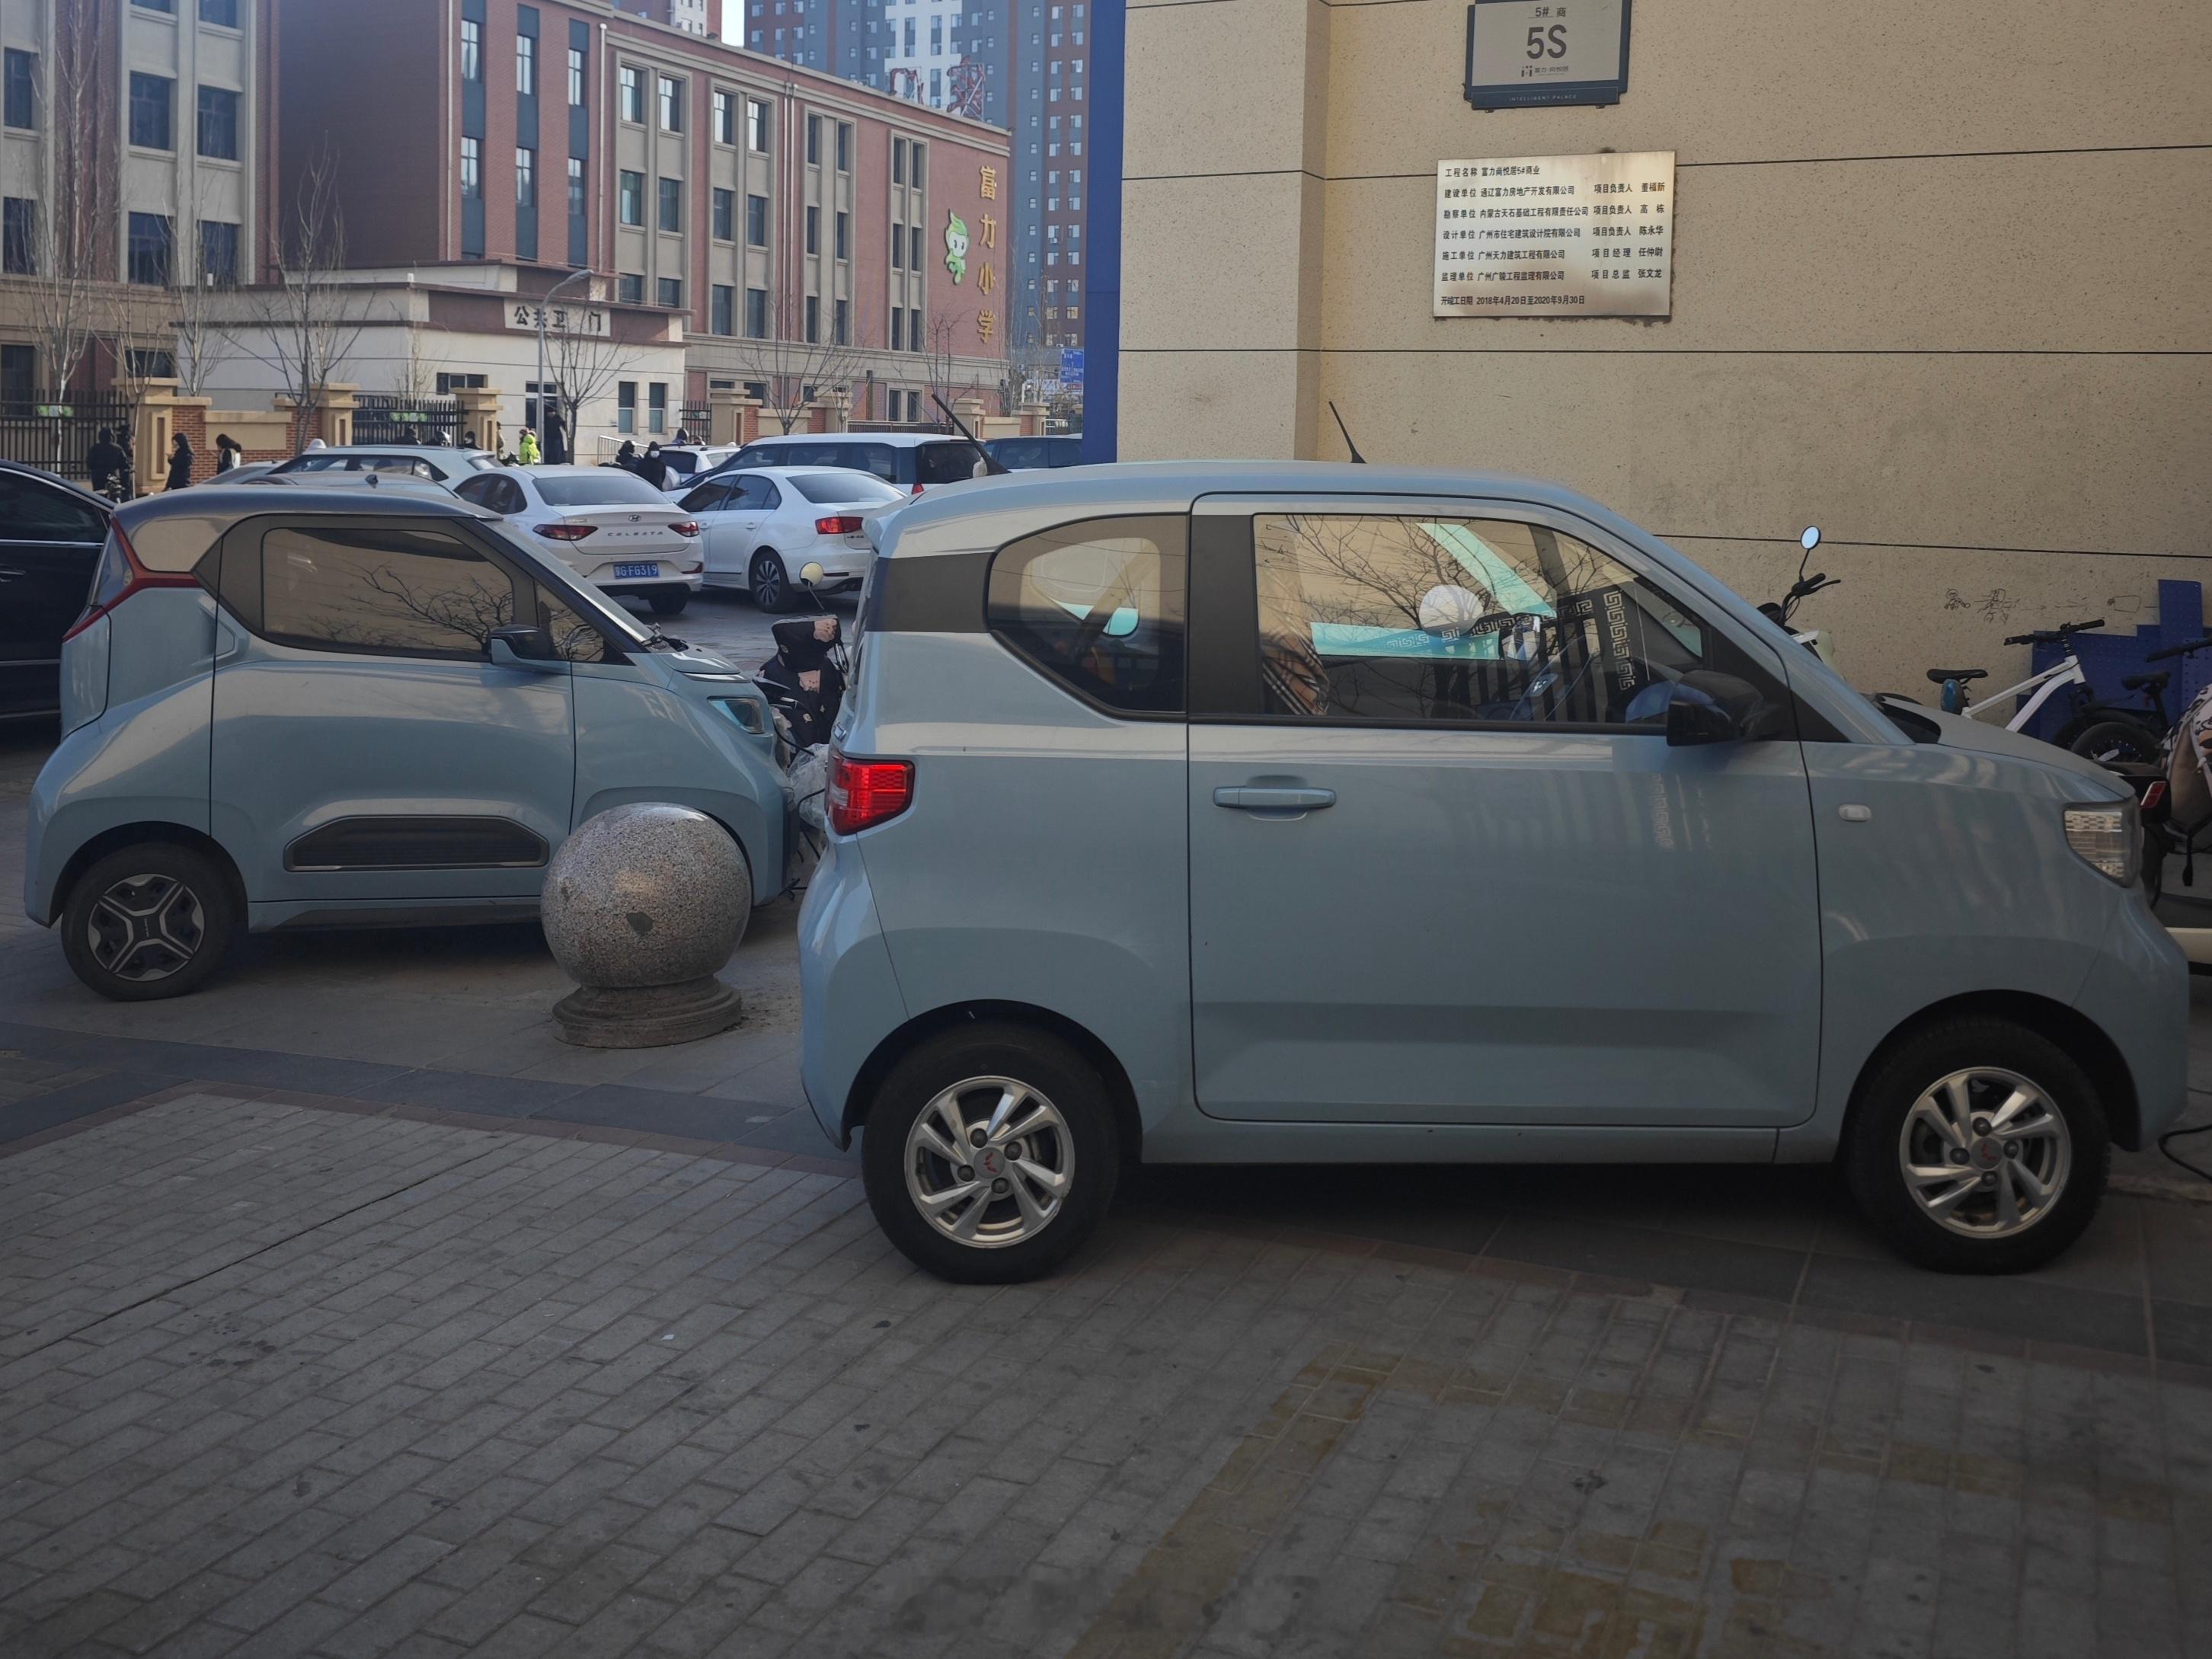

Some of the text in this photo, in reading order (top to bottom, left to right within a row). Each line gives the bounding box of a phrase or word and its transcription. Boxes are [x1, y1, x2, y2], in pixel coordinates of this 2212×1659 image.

[1556, 7, 1567, 18] 商
[1526, 24, 1568, 59] 5S
[1445, 167, 1478, 177] 工程名称
[1444, 188, 1477, 198] 建设单位
[1480, 185, 1574, 198] 通辽富力房地产开发有限公司
[1593, 183, 1633, 193] 项目负责人
[1443, 209, 1476, 219] 勘察单位
[1479, 206, 1589, 219] 内蒙古天石基础工程有限责任公司
[1593, 205, 1632, 216] 项目负责人
[1443, 225, 1664, 240] 设计单位 广州市住宅建筑设计院有限公司 项目负责人 陈永华
[977, 165, 997, 344] 富力小学
[1442, 251, 1475, 261] 施工单位
[1478, 249, 1565, 261] 广州天力建筑工程有限公司
[1591, 248, 1632, 258] 项目经理
[1441, 268, 1663, 282] 监理单位 广州广骏工程监理有限公司 项目总监 张文龙
[1476, 295, 1585, 305] 2018年4月20日至2020年9月30日
